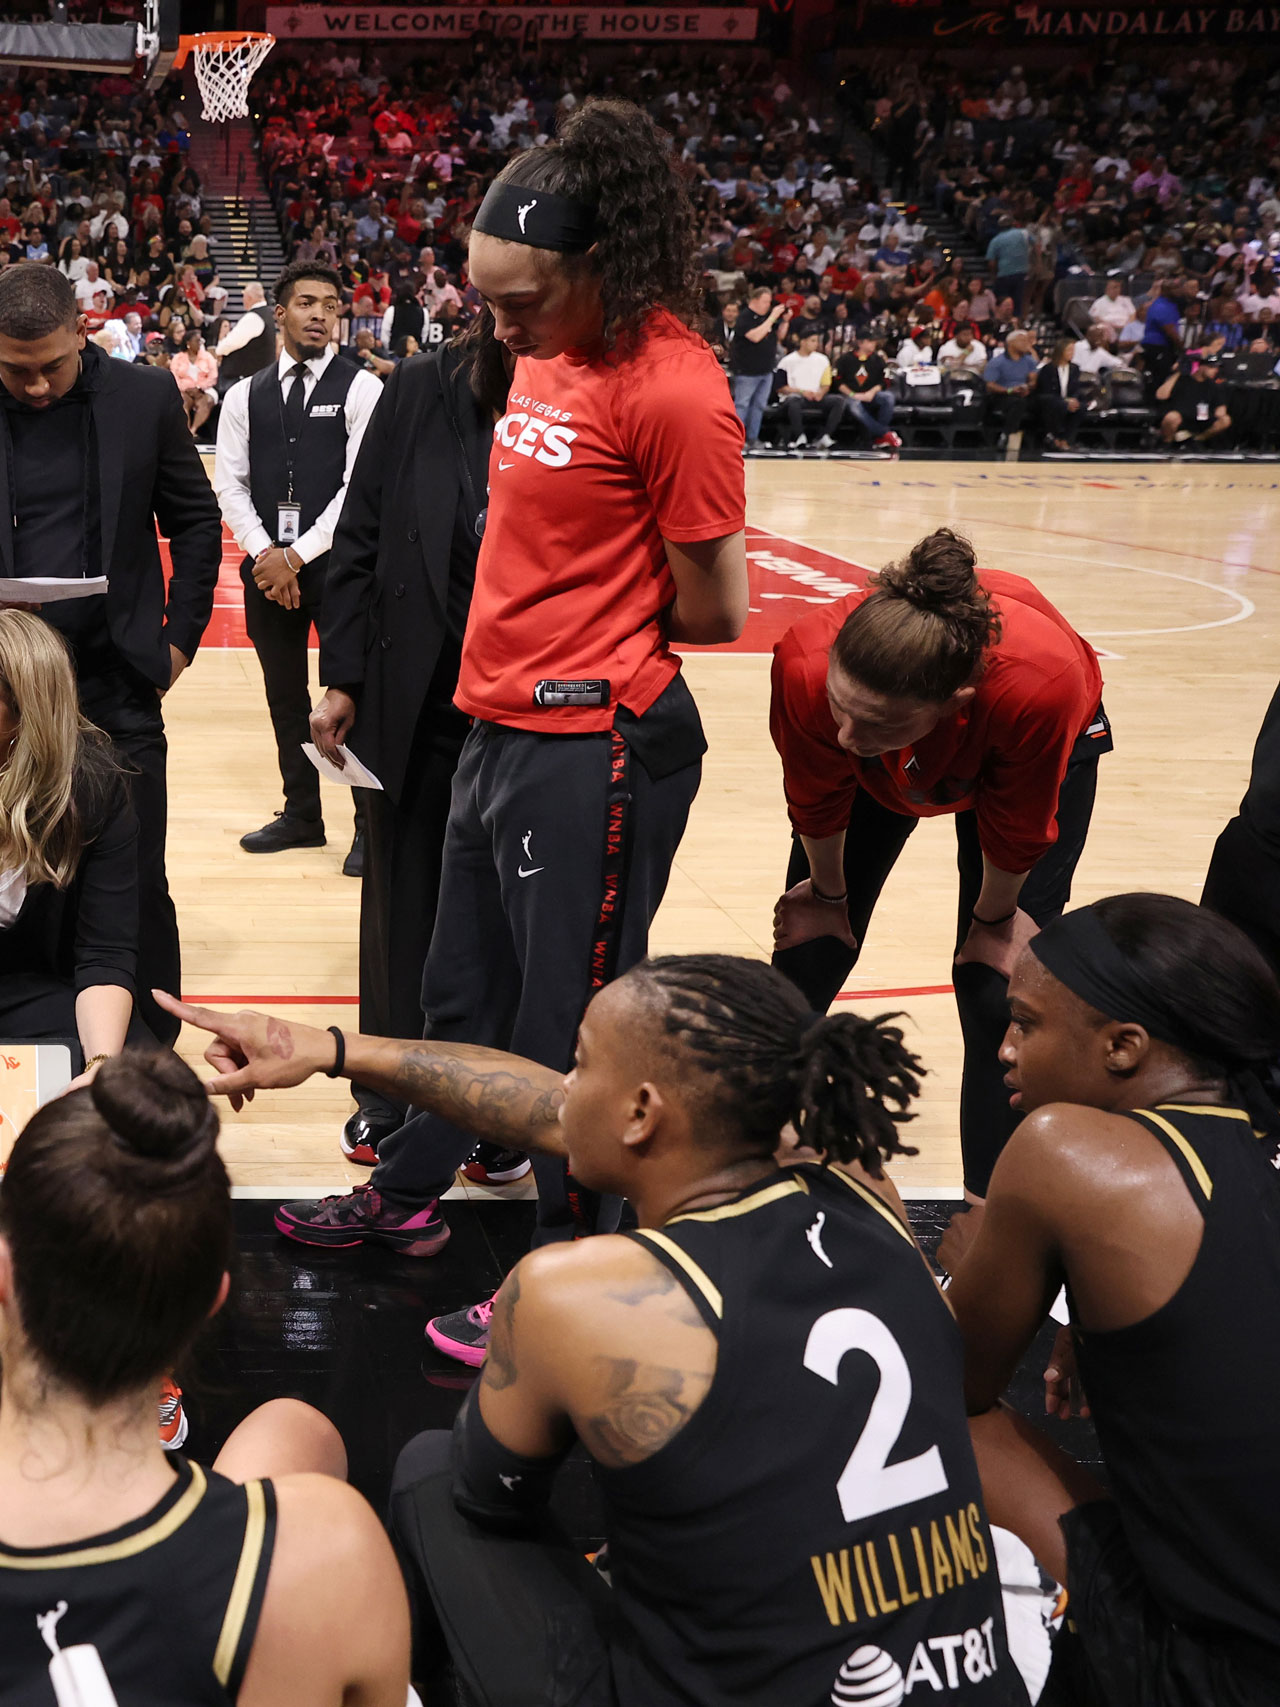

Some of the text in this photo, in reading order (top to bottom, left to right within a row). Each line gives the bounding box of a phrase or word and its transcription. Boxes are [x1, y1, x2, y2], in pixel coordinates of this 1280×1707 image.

[324, 14, 474, 31] WELCOME
[535, 14, 589, 32] THE
[601, 14, 700, 32] HOUSE
[1025, 10, 1216, 35] MANDALAY
[311, 404, 341, 413] BEST
[510, 392, 573, 422] LAS VEGAS
[607, 802, 624, 855] WNBA
[599, 873, 619, 923] WNBA
[803, 1307, 949, 1523] 2
[811, 1502, 988, 1626] WILLIAMS
[904, 1616, 999, 1696] AT&T
